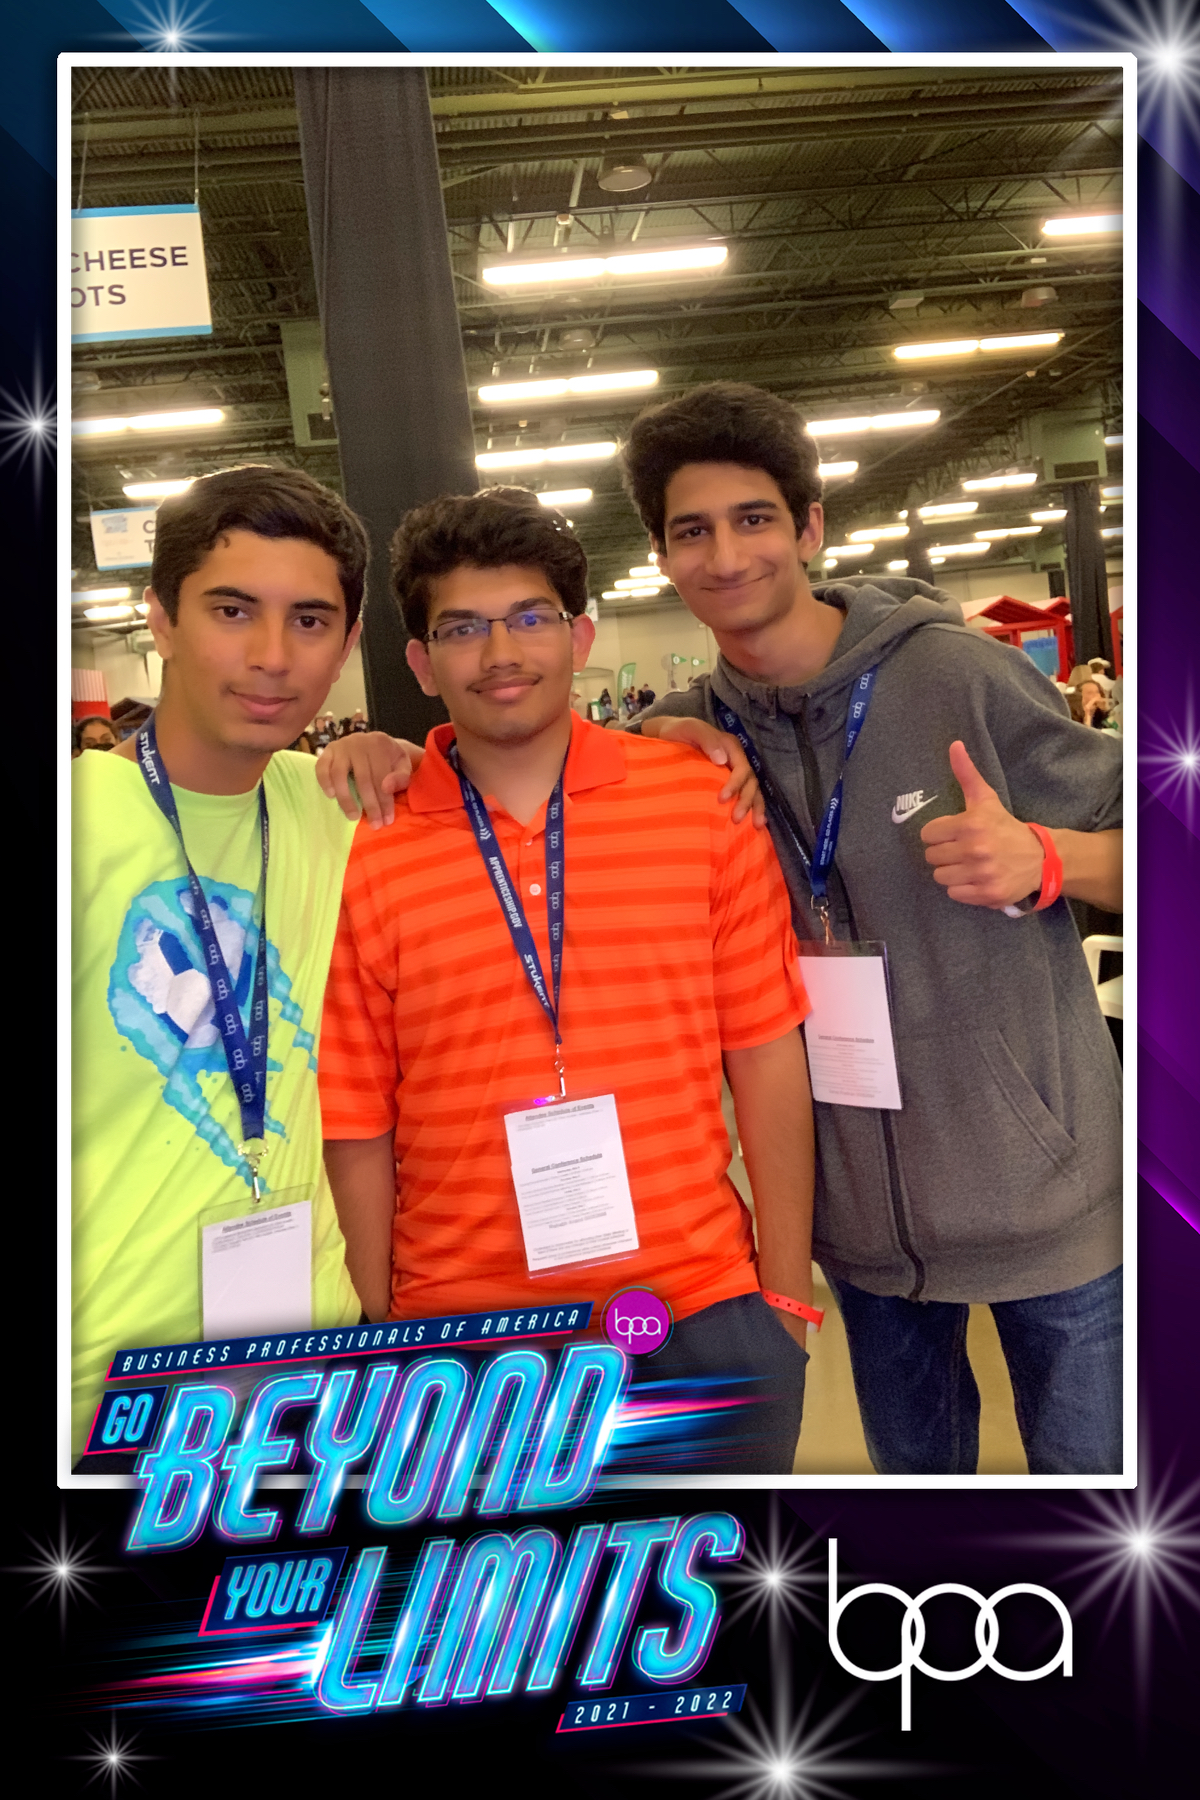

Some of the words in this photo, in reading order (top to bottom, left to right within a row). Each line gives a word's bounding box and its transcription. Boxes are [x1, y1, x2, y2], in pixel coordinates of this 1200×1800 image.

[71, 246, 189, 273] CHEESE
[896, 790, 924, 812] NIKE
[488, 856, 522, 928] APPRENTICESHIP.GOV
